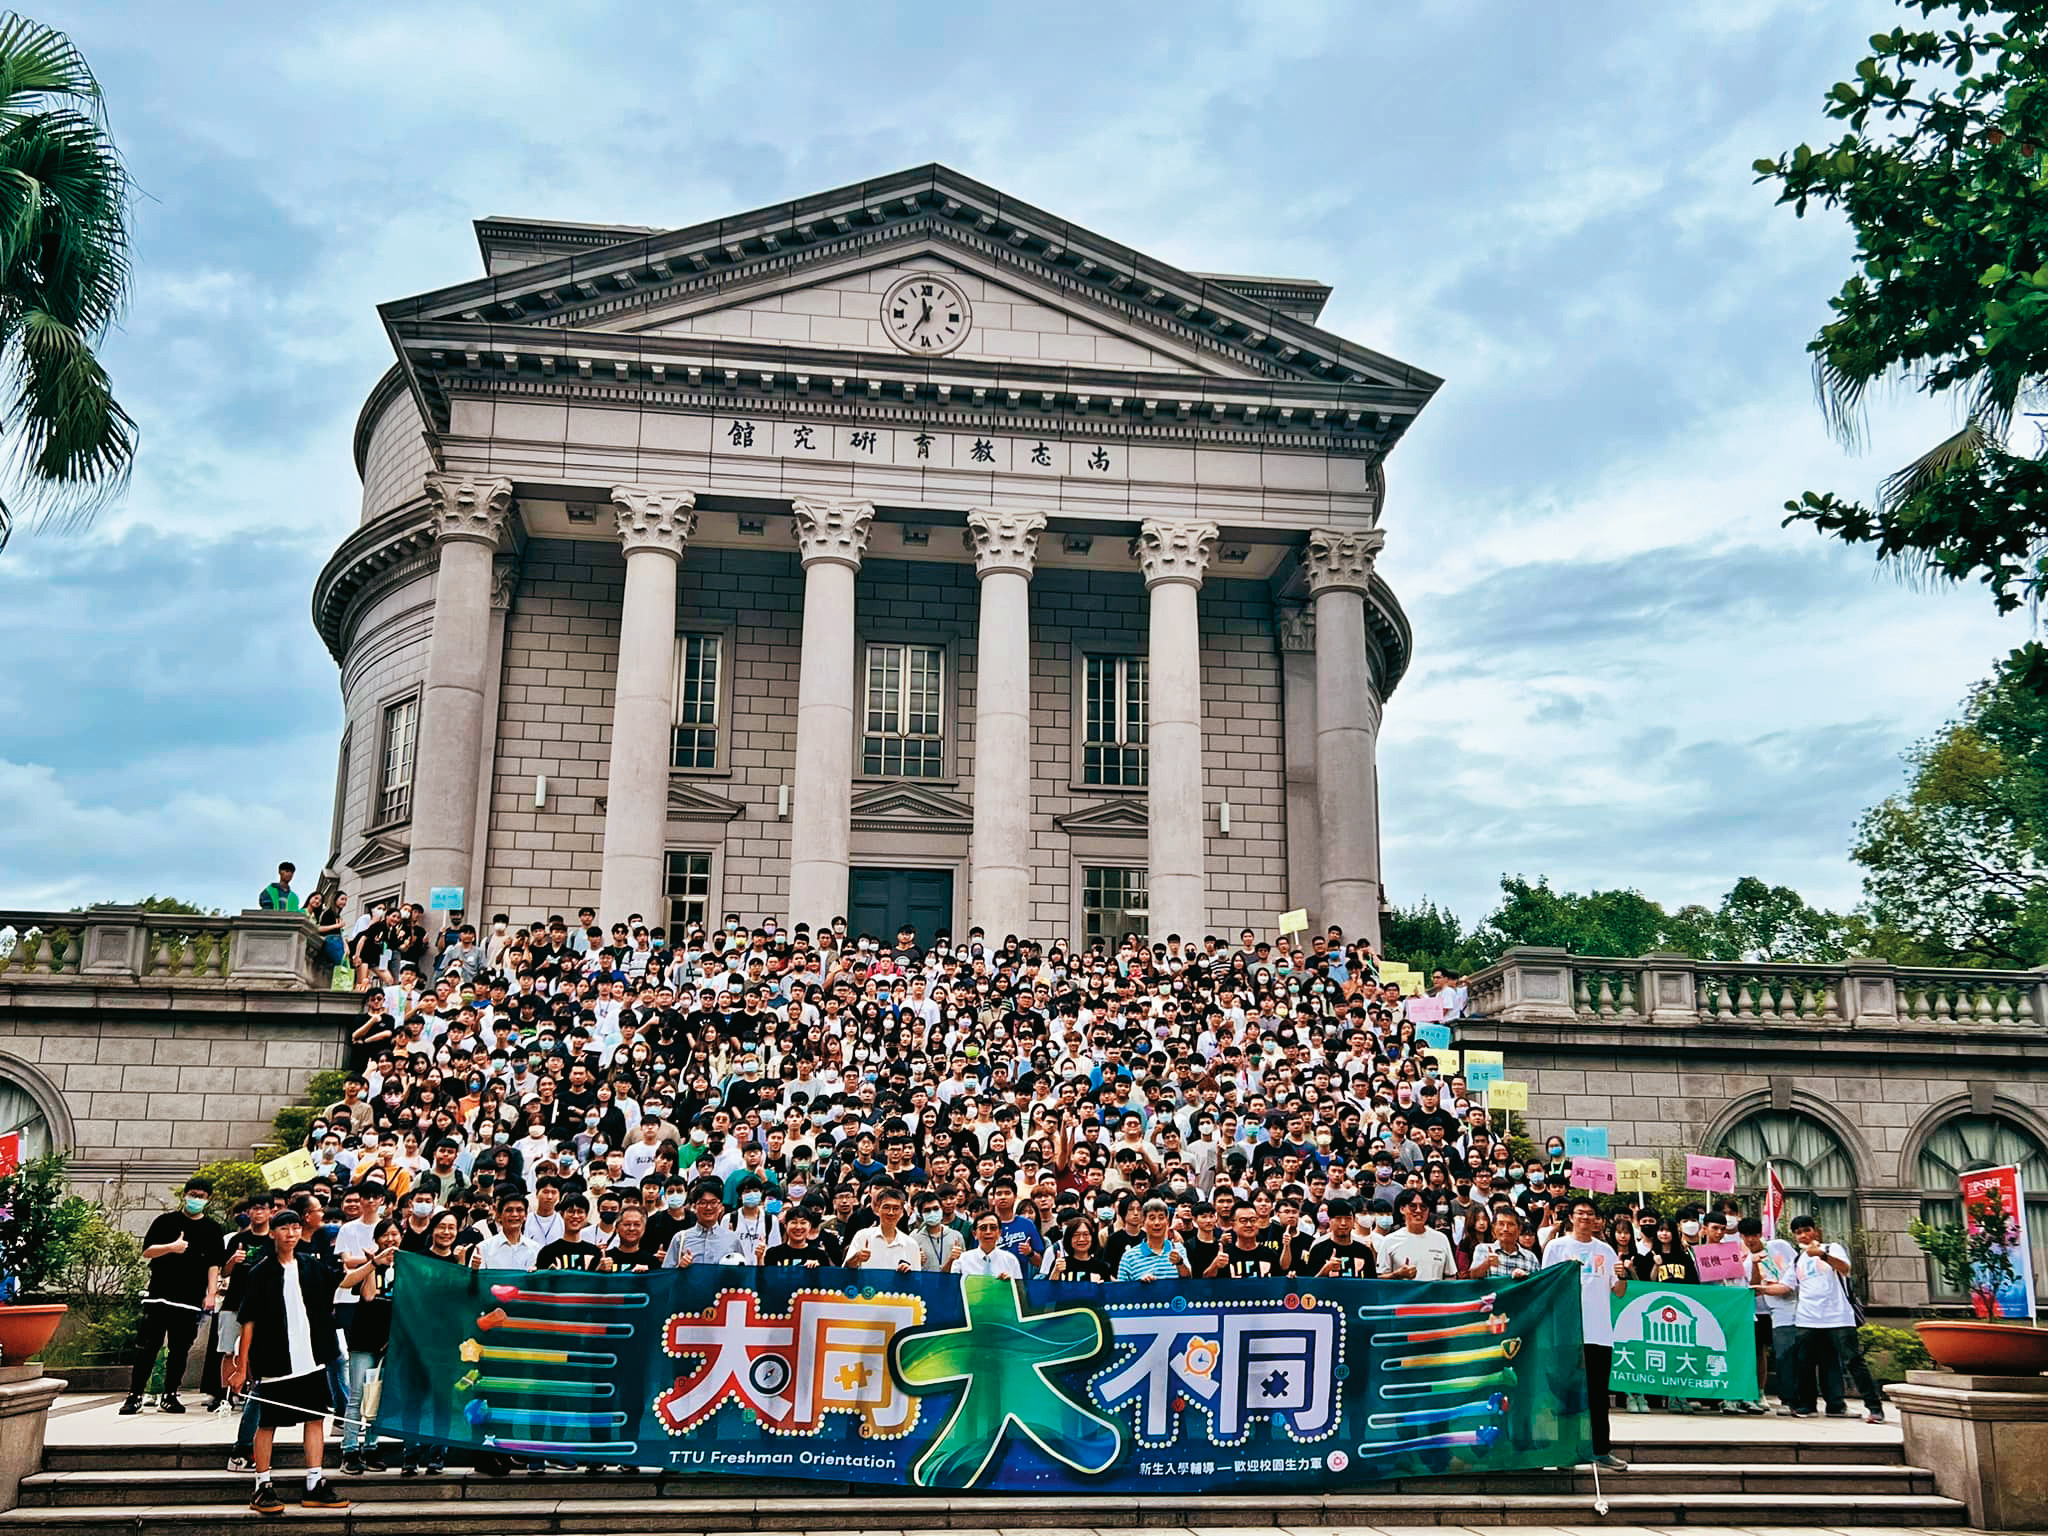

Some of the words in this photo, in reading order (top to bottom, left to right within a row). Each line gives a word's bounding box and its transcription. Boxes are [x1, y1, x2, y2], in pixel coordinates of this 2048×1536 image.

[1614, 1346, 1728, 1377] 大同大學
[1612, 1370, 1656, 1384] TATUNG
[1661, 1376, 1729, 1389] UNIVERSITY
[669, 1450, 705, 1464] TTU
[710, 1450, 794, 1464] Freshman
[799, 1451, 896, 1469] Orientation
